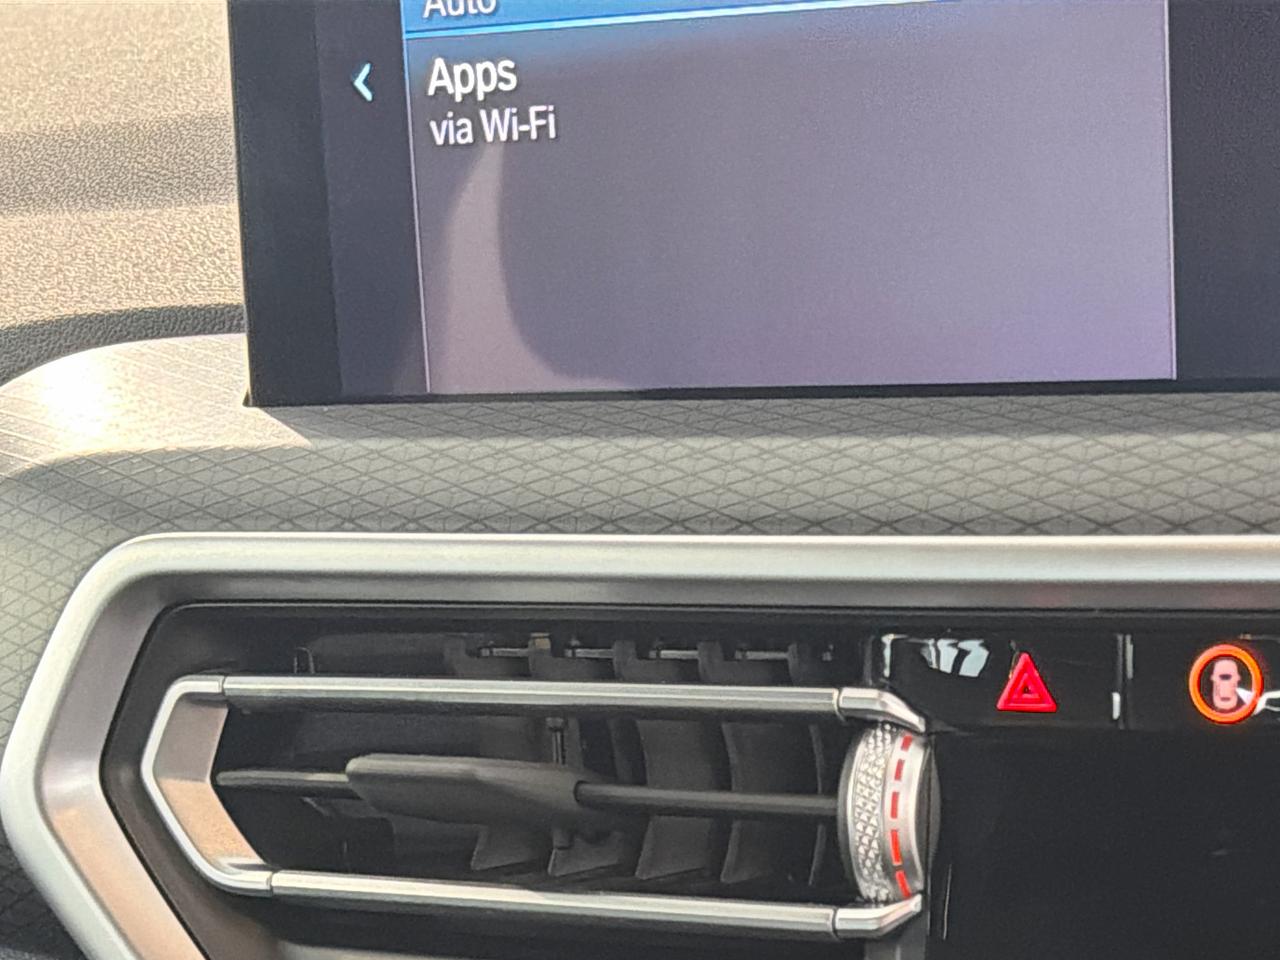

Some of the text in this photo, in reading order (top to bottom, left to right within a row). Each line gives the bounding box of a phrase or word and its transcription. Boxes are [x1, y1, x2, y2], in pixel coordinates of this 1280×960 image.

[427, 57, 517, 102] Apps
[430, 105, 556, 145] via Wi-Fi
